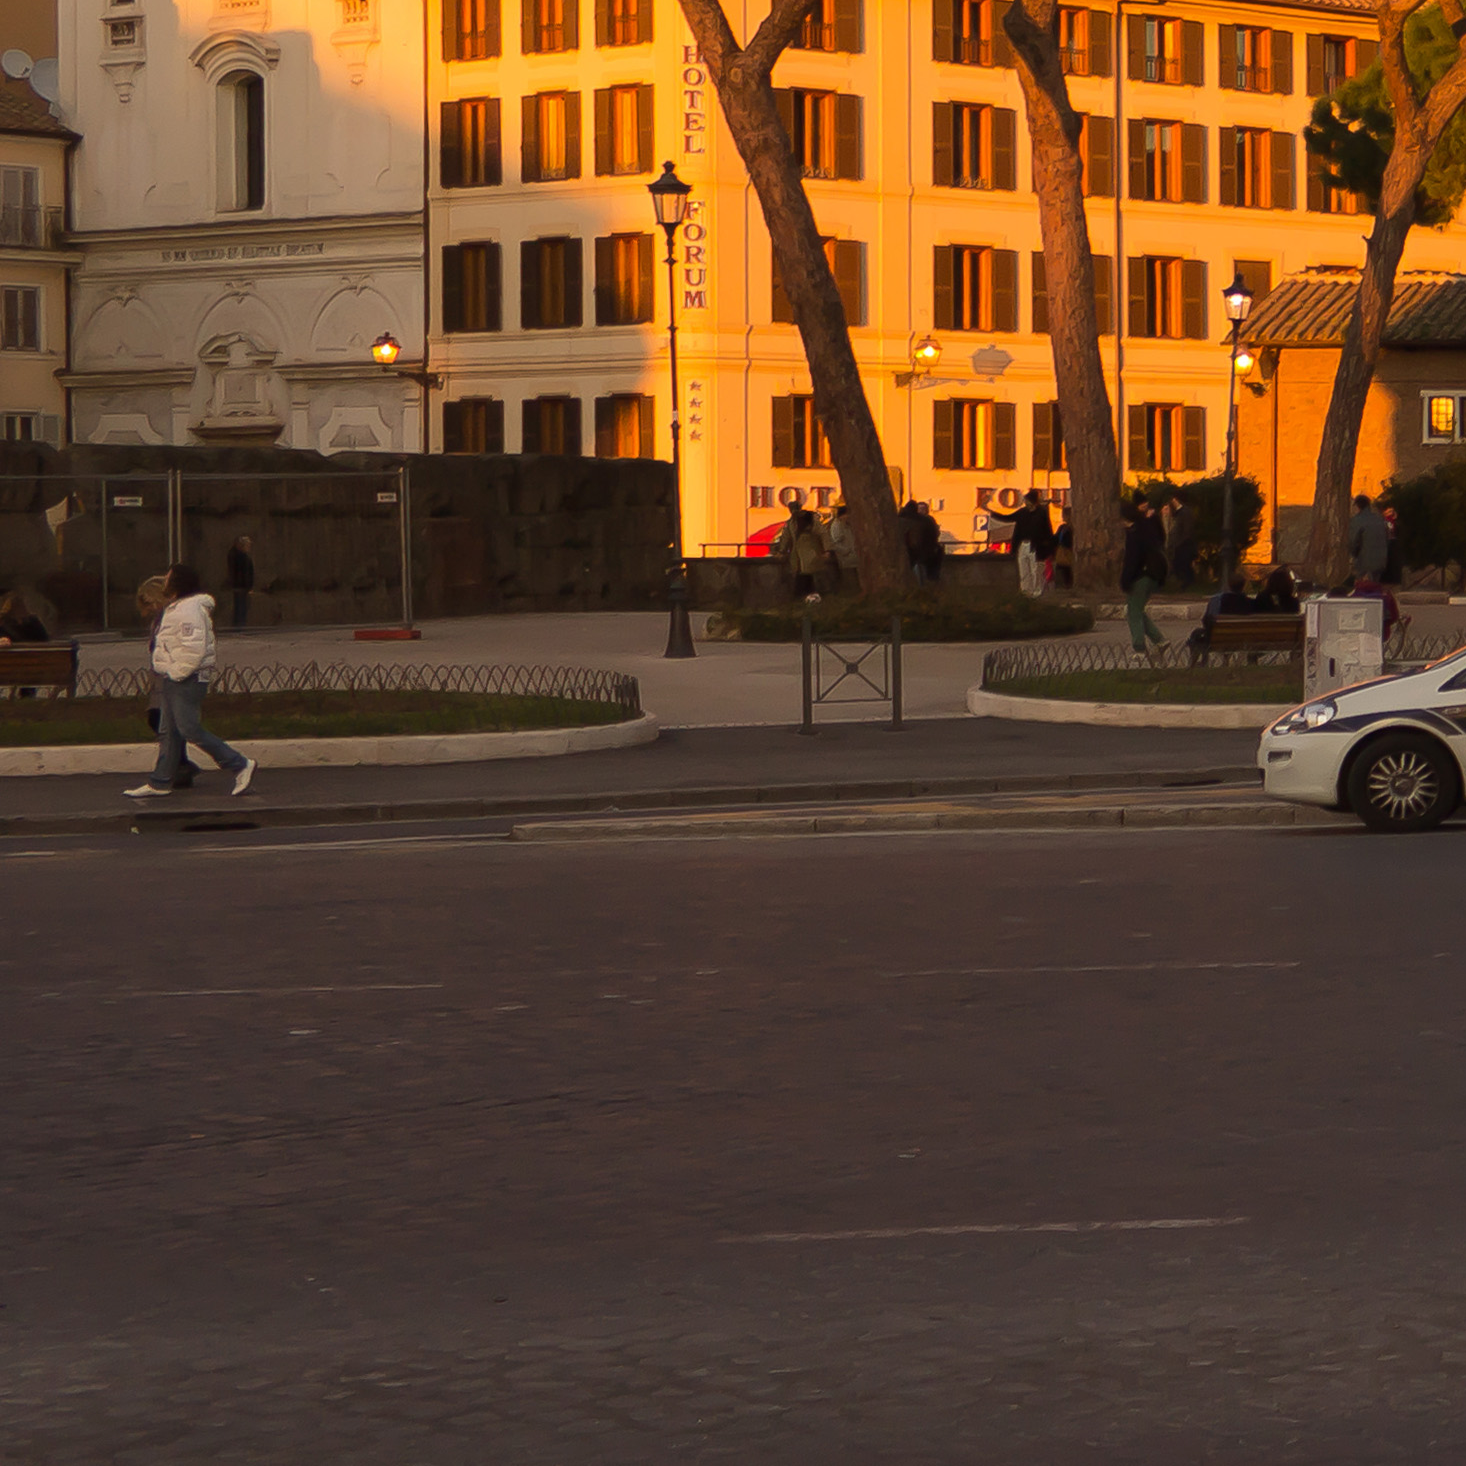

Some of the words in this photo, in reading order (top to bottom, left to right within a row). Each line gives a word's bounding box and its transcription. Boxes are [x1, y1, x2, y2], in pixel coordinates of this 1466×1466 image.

[682, 45, 706, 153] HOTEL
[682, 201, 708, 309] FORUM
[749, 486, 836, 508] HOT
